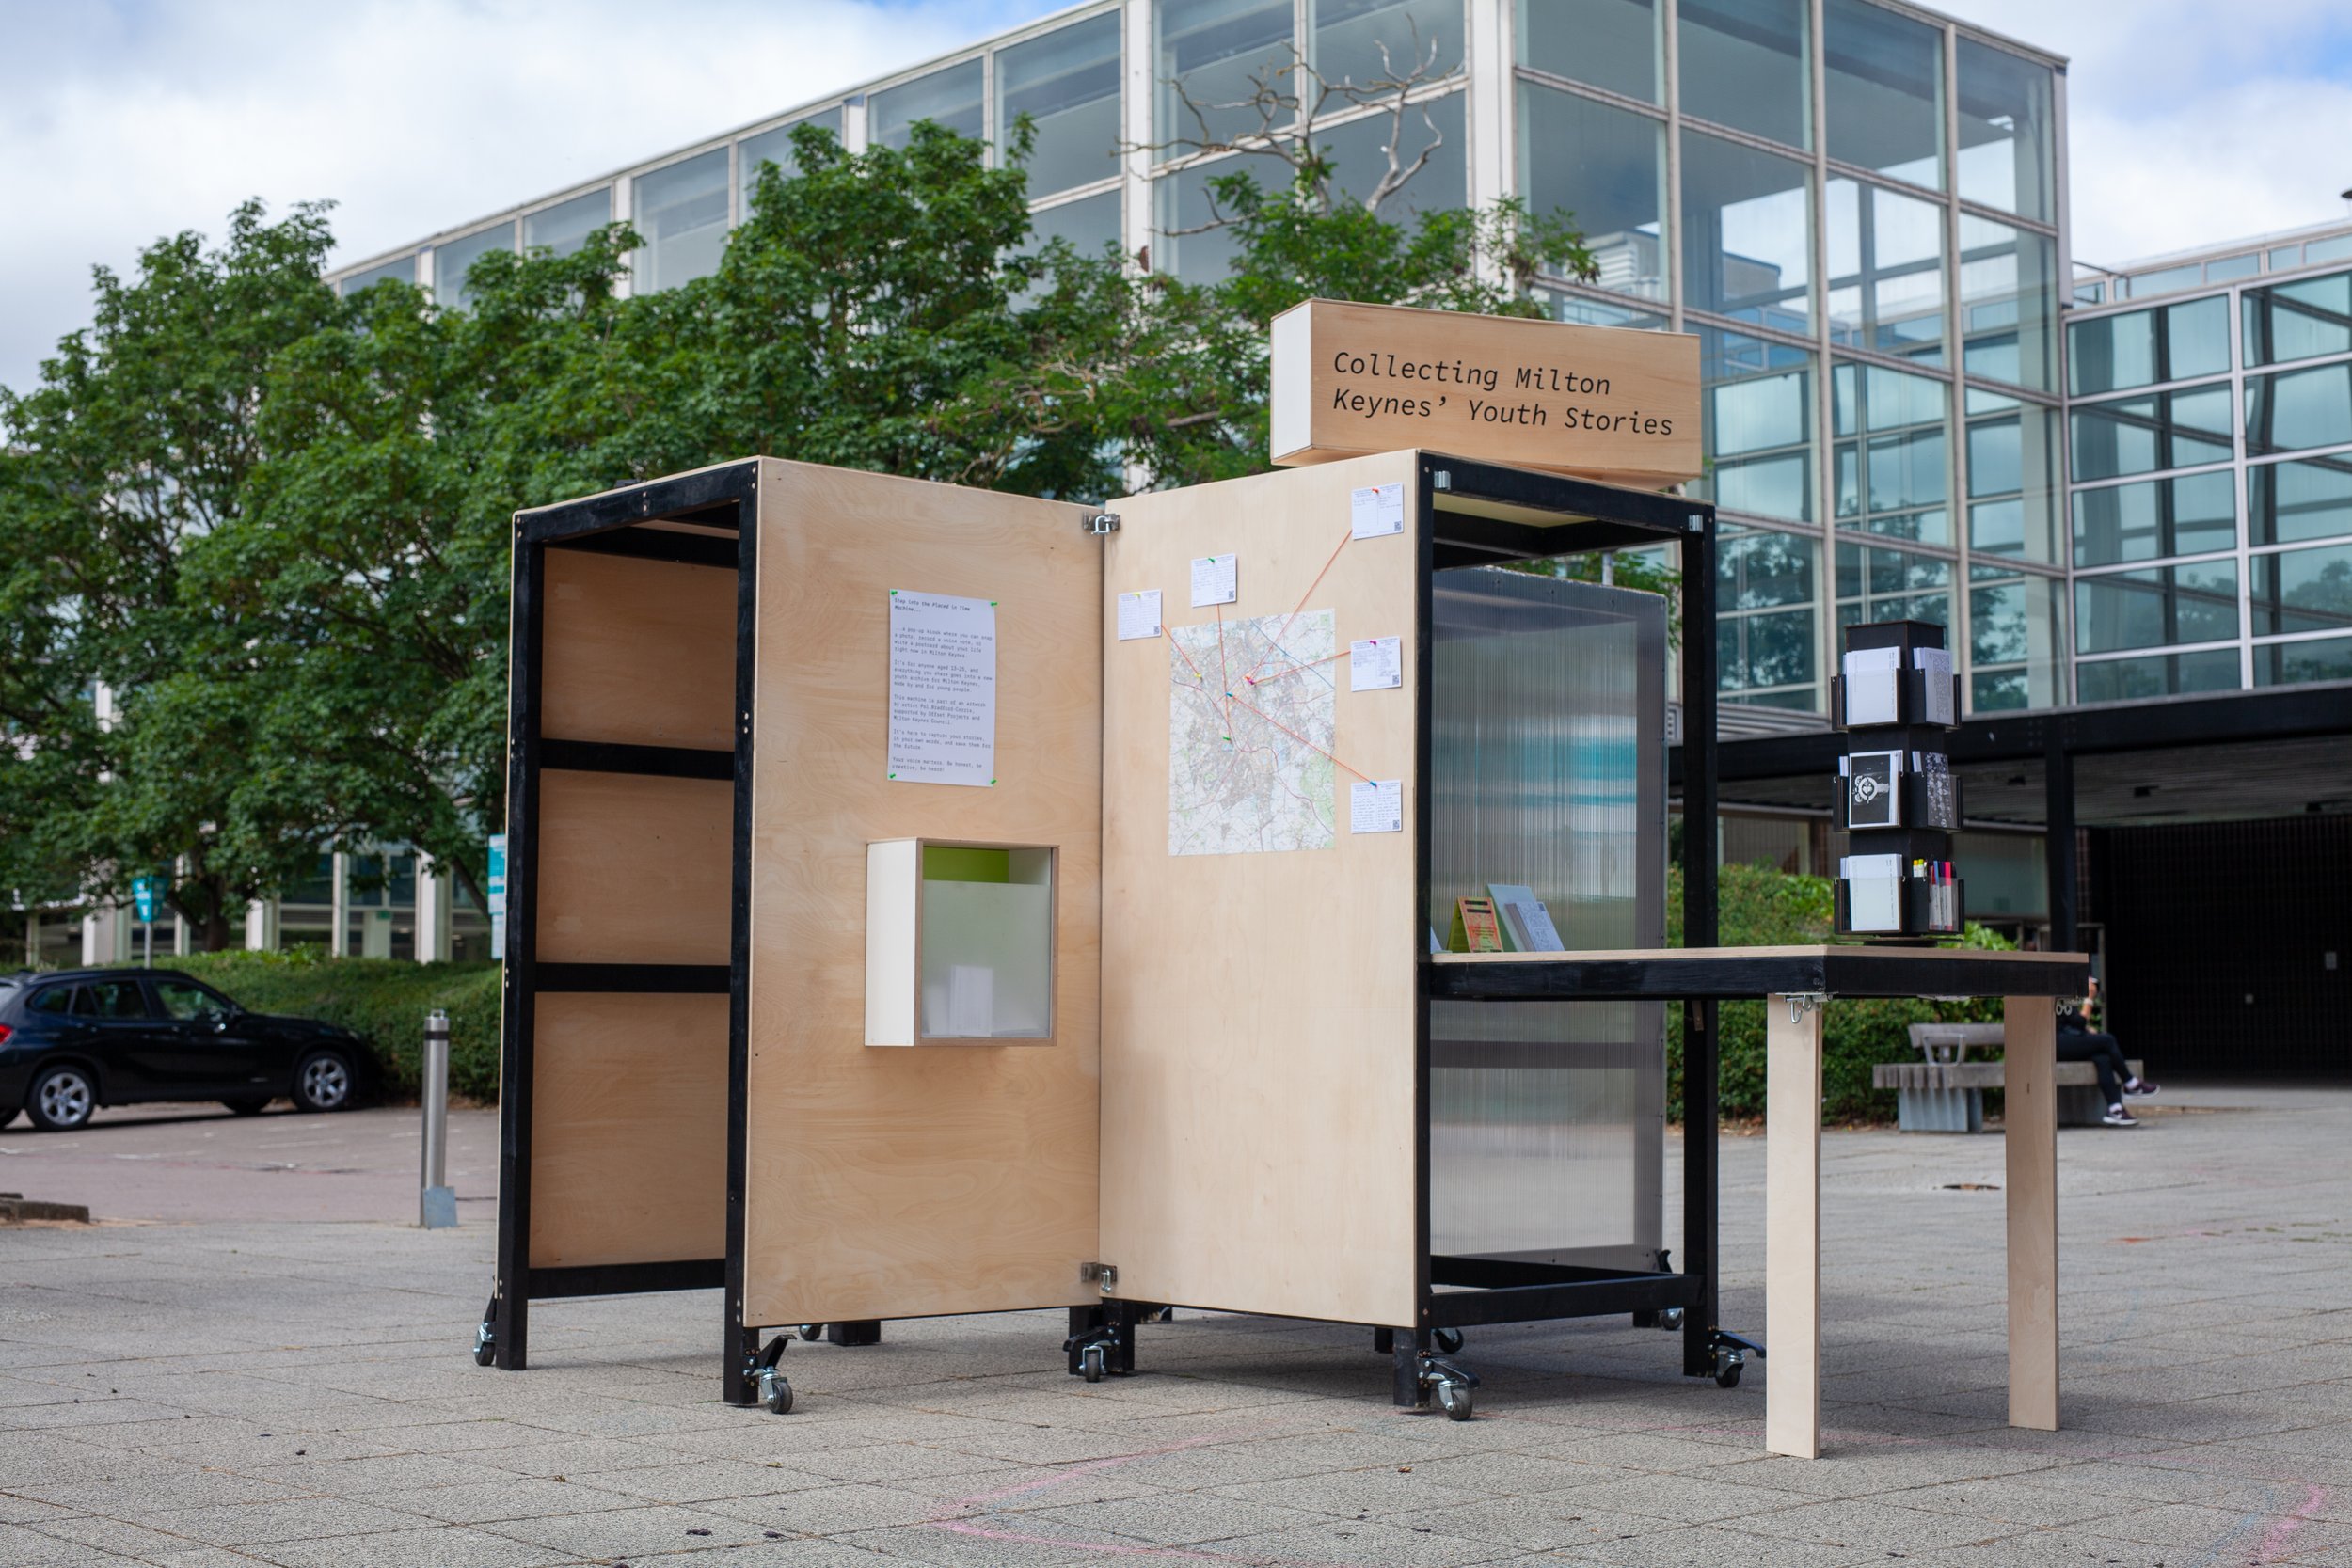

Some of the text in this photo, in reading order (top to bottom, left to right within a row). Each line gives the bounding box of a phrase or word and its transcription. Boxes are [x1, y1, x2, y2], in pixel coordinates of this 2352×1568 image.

[1334, 352, 1610, 395] Collecting Milton
[1333, 388, 1673, 436] Keynes’ Youth Stories
